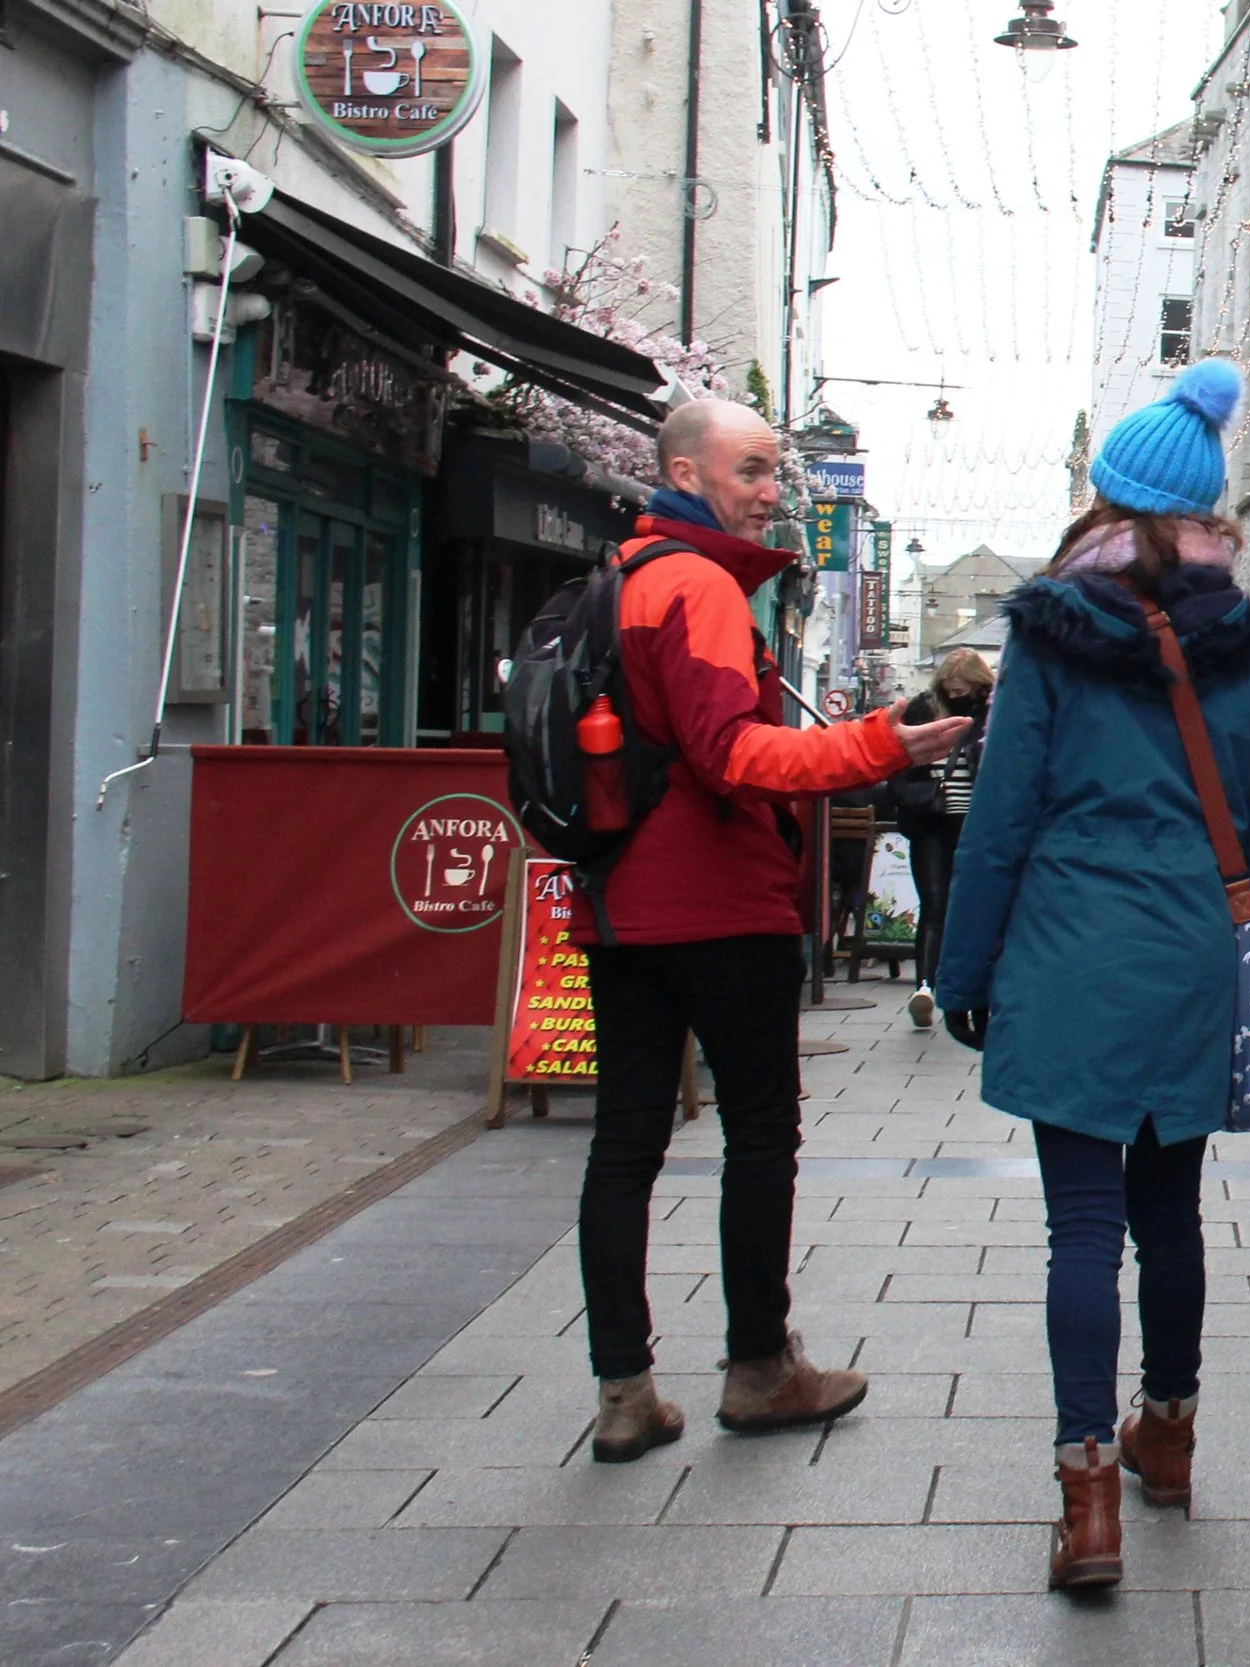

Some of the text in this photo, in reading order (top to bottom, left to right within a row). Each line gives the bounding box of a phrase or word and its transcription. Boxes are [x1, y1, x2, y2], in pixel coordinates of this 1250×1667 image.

[332, 2, 444, 34] ANFORA
[333, 102, 438, 120] Bistro Café
[864, 580, 877, 634] TATTOO
[411, 819, 509, 842] ANFORA
[534, 873, 574, 901] AN
[413, 900, 496, 912] Bistro Café
[550, 906, 573, 919] Bis
[551, 953, 590, 967] PAS
[560, 975, 591, 989] GR
[541, 1017, 596, 1032] BURG
[552, 1039, 597, 1053] CAK
